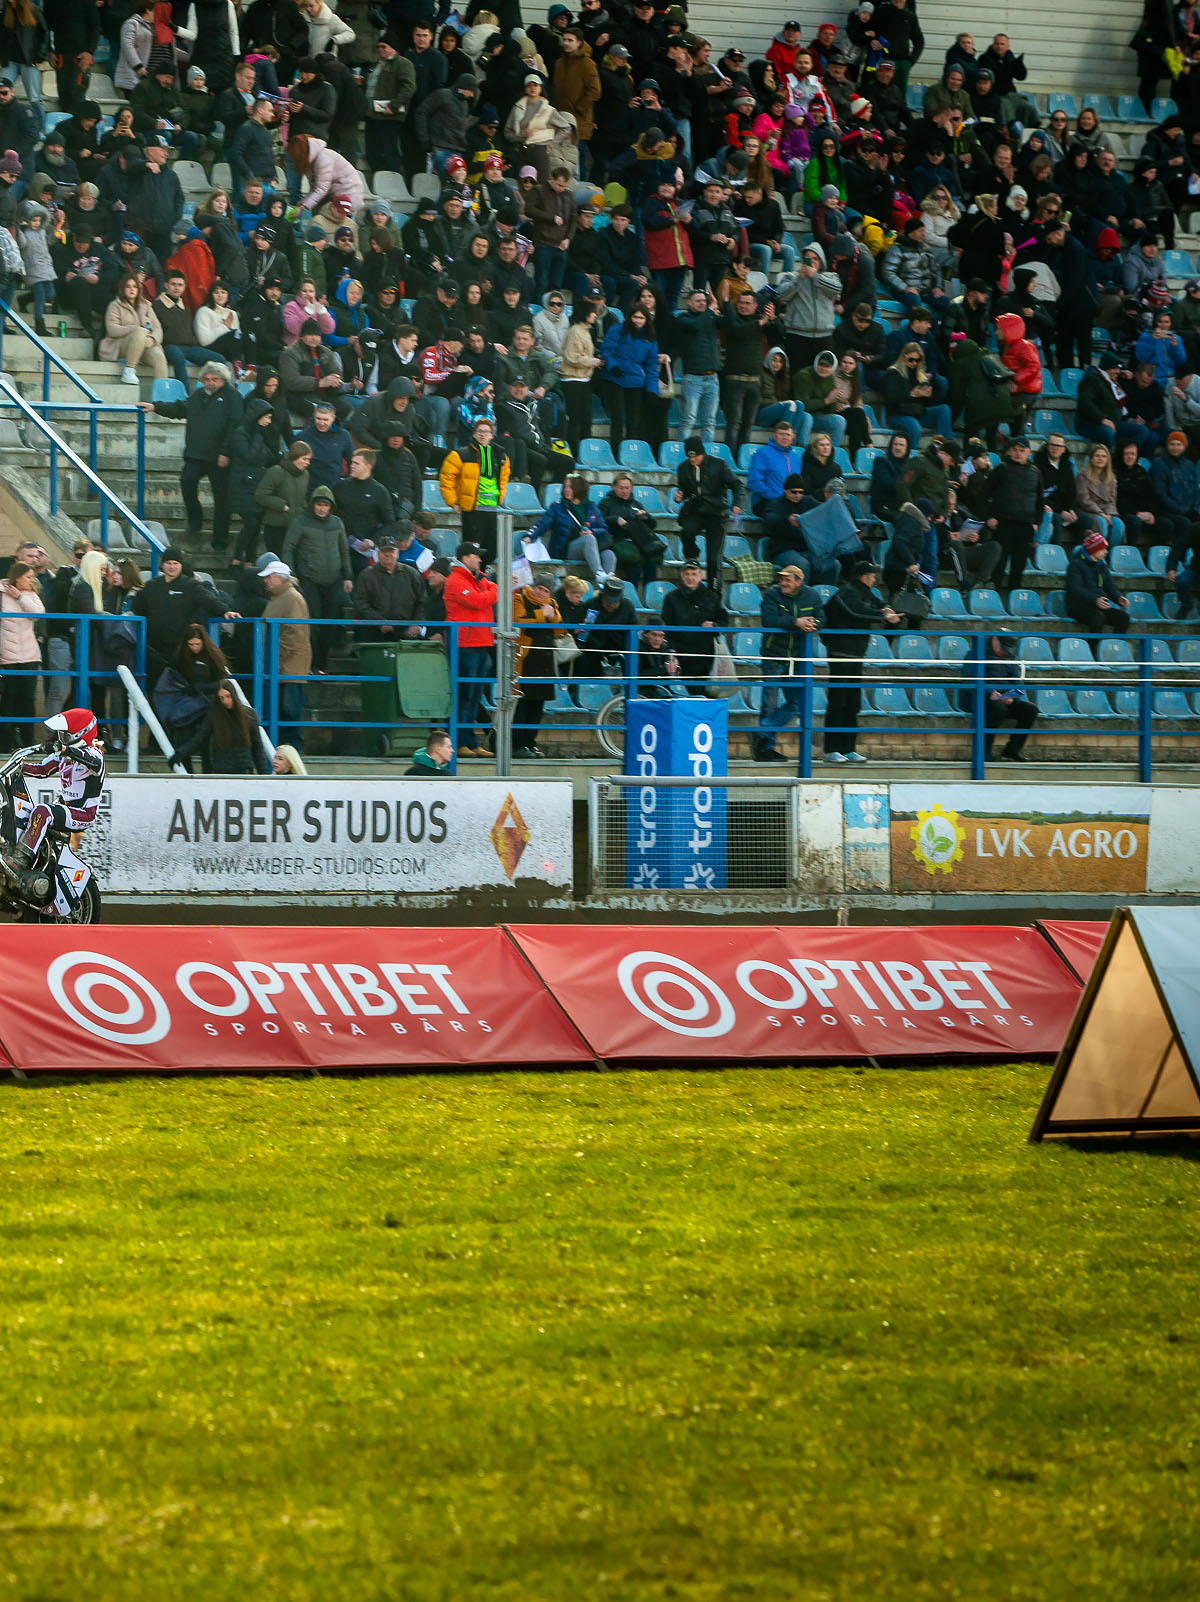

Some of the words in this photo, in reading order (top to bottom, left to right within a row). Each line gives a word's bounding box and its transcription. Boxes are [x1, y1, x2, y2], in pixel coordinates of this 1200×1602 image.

[636, 723, 658, 855] trodo
[688, 722, 713, 855] trodo
[167, 798, 292, 843] AMBER
[302, 799, 448, 844] STUDIOS
[976, 828, 1036, 857] LVK
[1048, 828, 1138, 859] AGRO
[193, 856, 427, 876] WWW.AMBER-STUDIOS.COM
[175, 960, 471, 1018] OPTIBET
[735, 958, 1013, 1012] OPTIBET
[202, 1020, 367, 1037] SPORTA
[390, 1017, 494, 1034] BĀRS
[766, 1013, 918, 1029] SPORTA
[938, 1010, 1036, 1028] BĀRS
